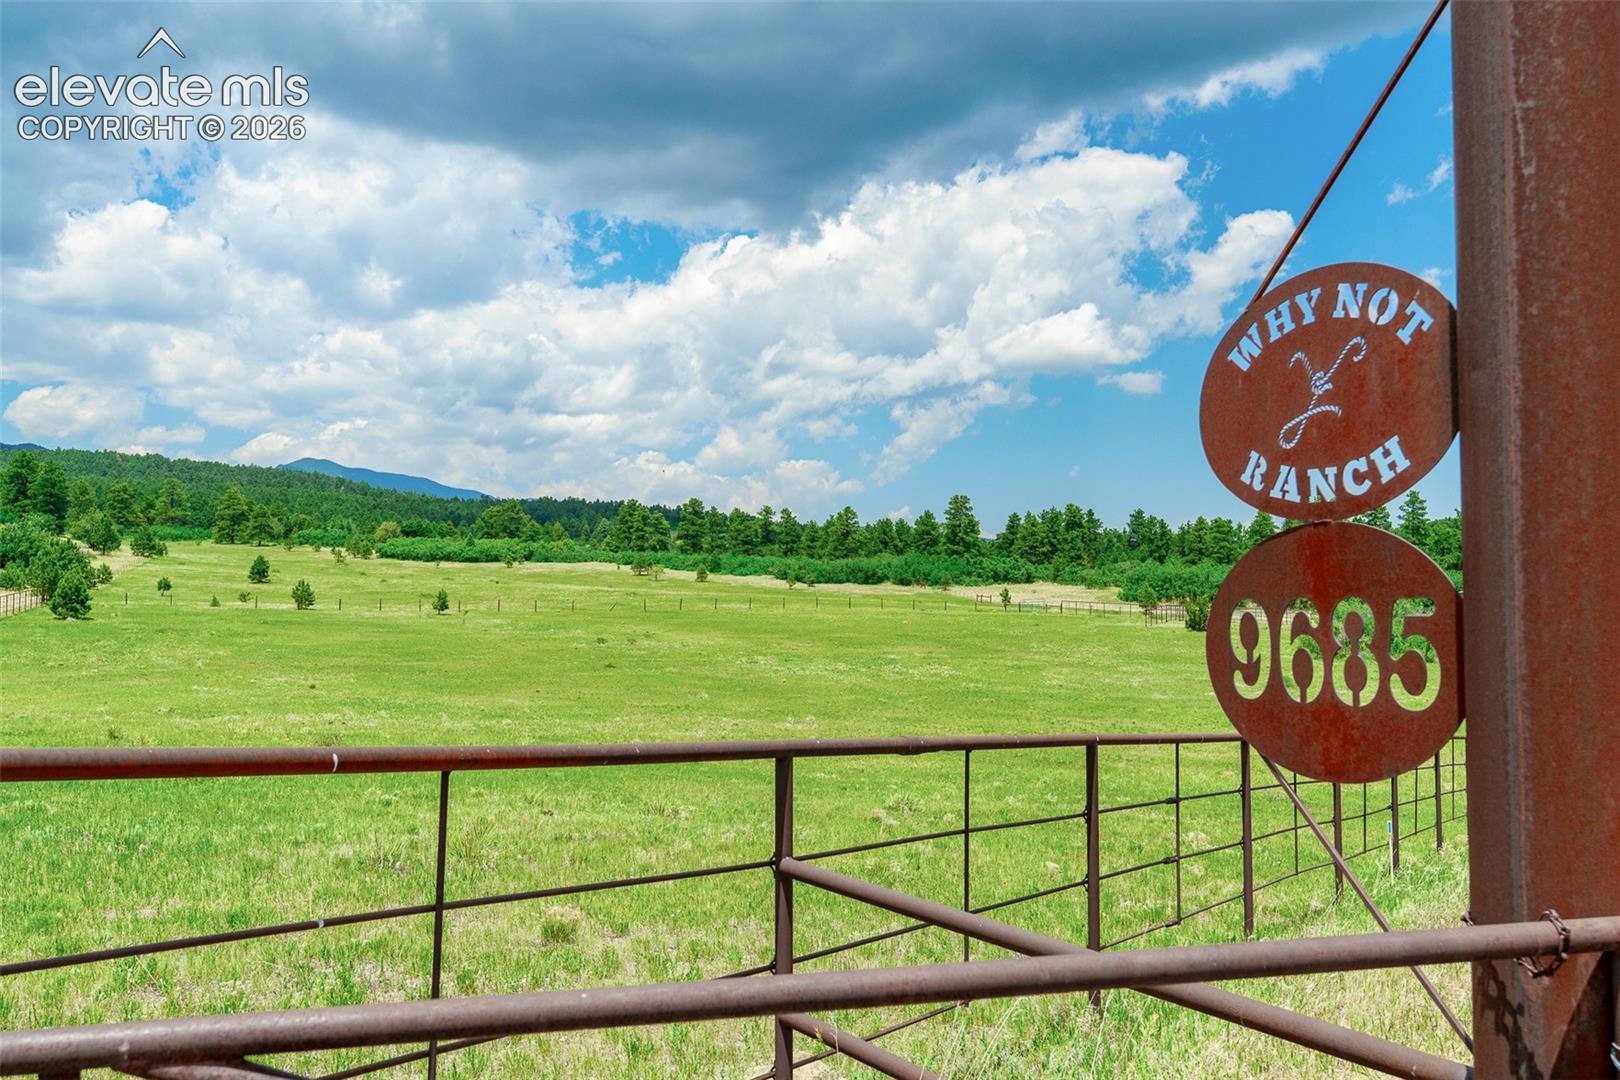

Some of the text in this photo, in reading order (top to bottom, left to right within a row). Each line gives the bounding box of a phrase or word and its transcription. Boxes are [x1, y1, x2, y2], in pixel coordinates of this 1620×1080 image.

[1227, 283, 1434, 372] WHY NOT
[1240, 435, 1411, 503] RANCH
[1230, 597, 1441, 712] 9685
